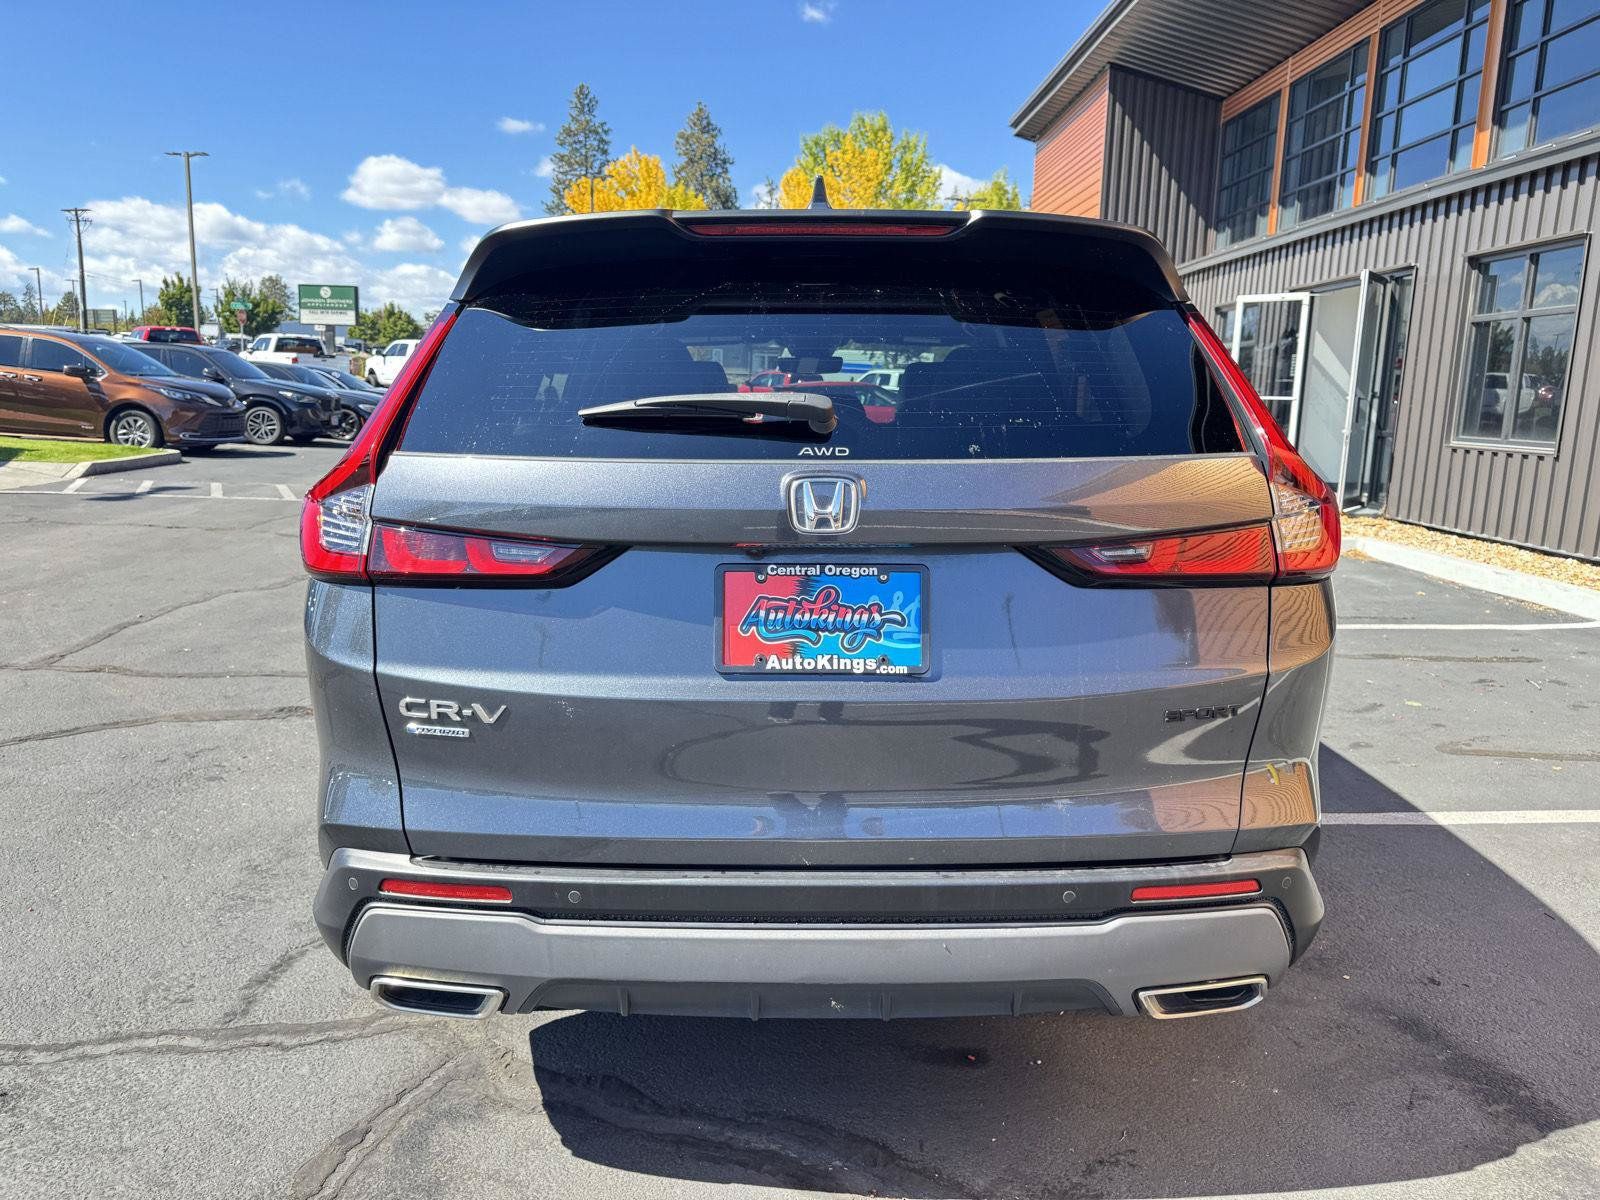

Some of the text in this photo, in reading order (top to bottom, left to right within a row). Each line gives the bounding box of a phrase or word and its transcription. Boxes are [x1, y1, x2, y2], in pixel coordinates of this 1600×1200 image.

[797, 446, 850, 457] AWD
[766, 564, 879, 579] Central Oregon
[398, 695, 507, 725] CR-V
[1165, 704, 1241, 722] SPORT
